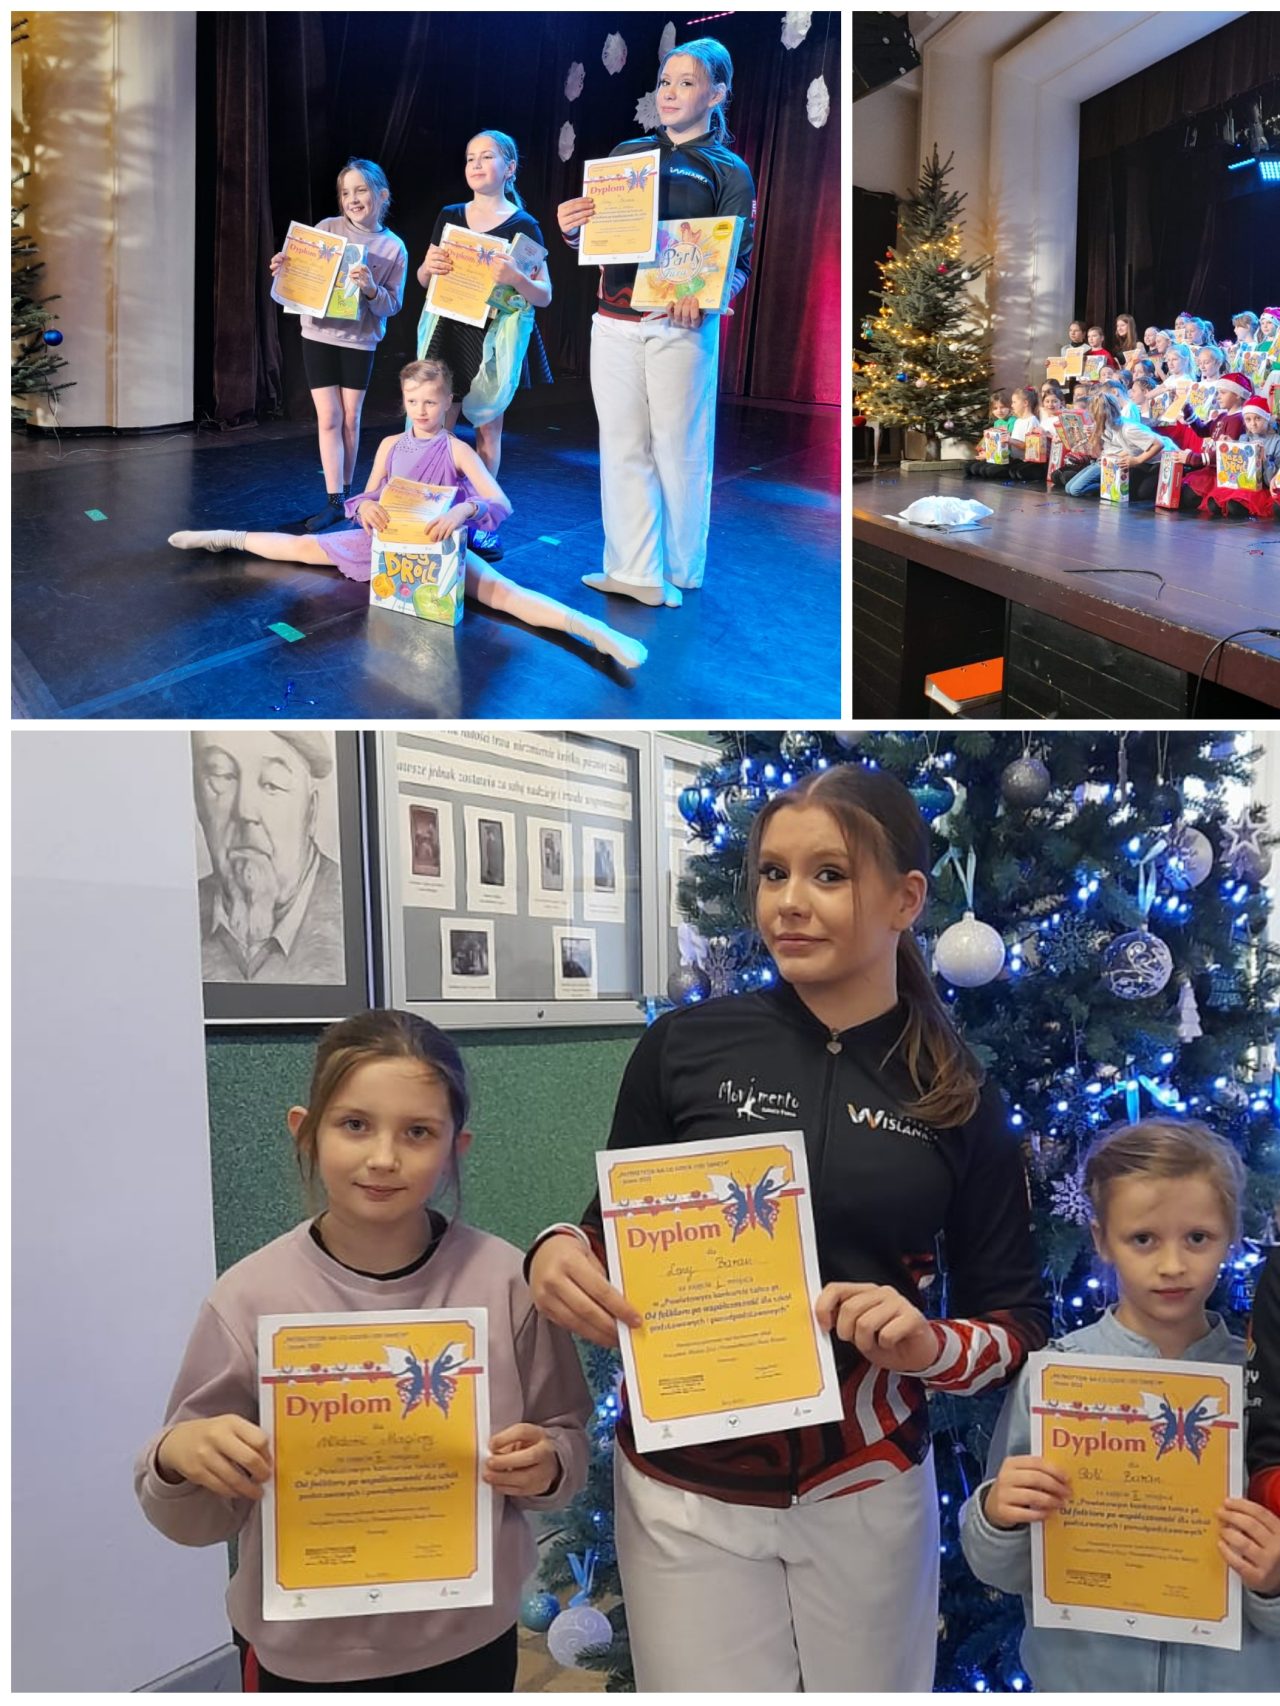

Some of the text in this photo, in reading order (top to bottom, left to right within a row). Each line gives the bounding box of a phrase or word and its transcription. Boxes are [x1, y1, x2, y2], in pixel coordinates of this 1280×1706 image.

[590, 185, 625, 196] Dyplom
[627, 1222, 721, 1253] Dyplom
[286, 1393, 391, 1423] Dyplom
[1052, 1428, 1146, 1457] Dyplom
